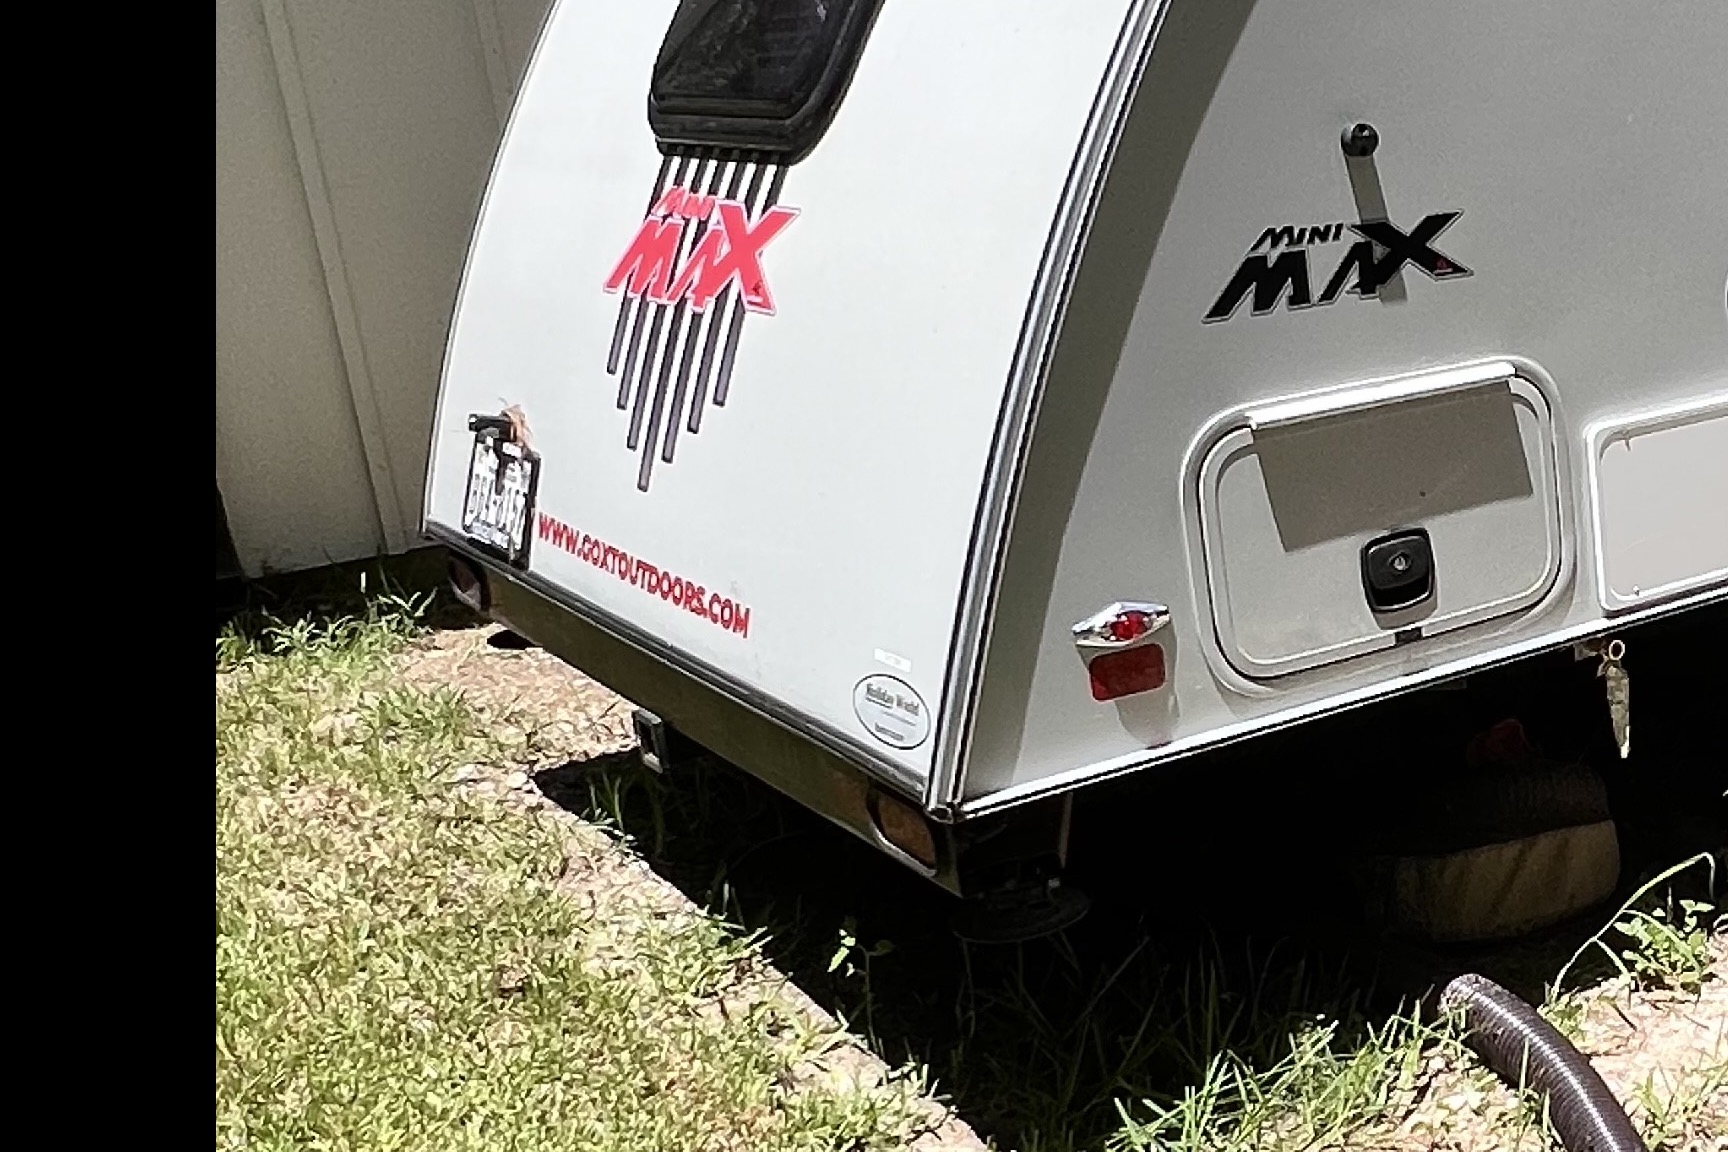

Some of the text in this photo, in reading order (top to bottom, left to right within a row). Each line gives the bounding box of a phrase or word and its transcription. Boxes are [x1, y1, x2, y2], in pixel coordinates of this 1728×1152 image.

[603, 200, 801, 316] MAX
[1201, 209, 1474, 324] MAX
[1250, 223, 1344, 253] MINI
